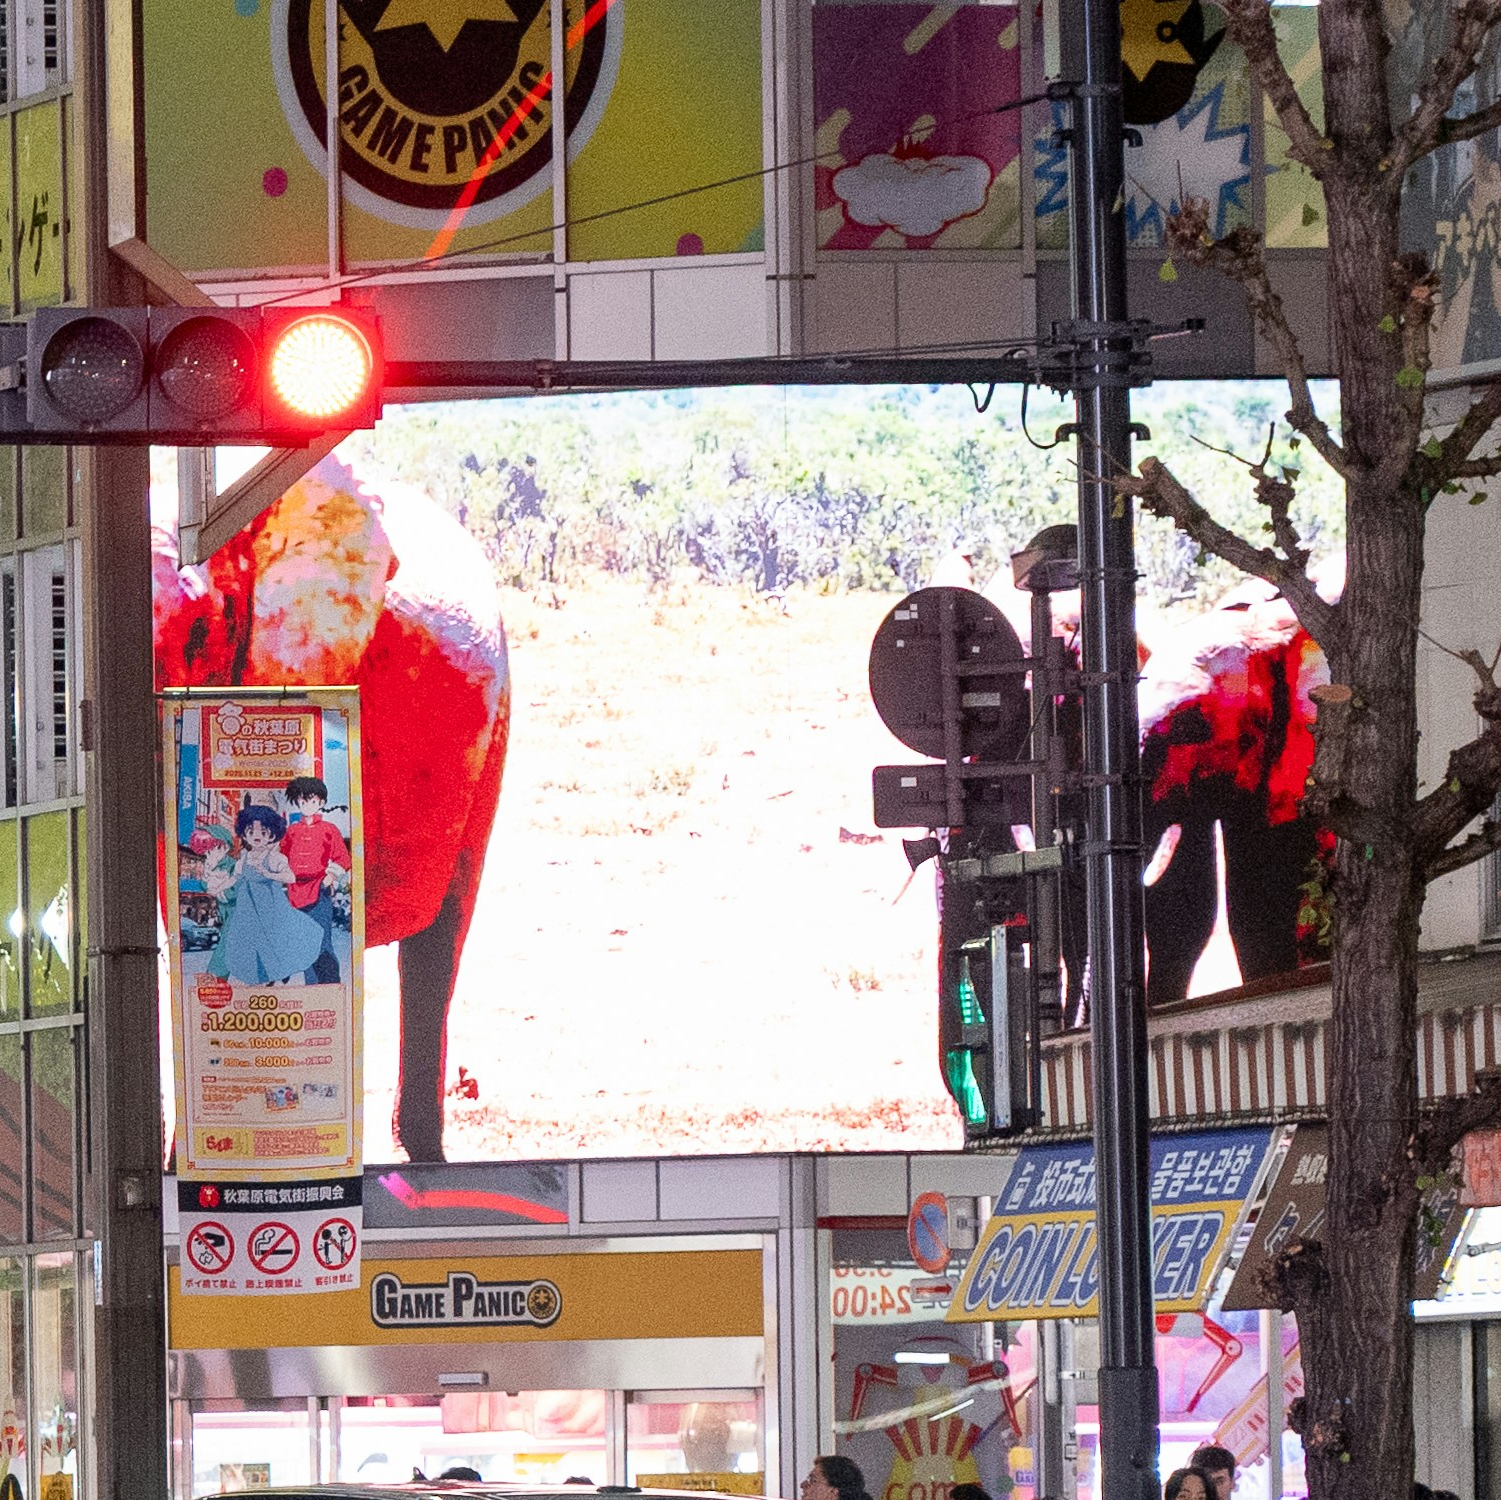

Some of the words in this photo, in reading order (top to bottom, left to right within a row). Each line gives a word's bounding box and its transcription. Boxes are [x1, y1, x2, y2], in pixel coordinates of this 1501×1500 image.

[339, 64, 436, 174] GAME
[224, 1185, 345, 1204] 秋葉原電気街振興会
[965, 1221, 1068, 1312] COIN
[1052, 1211, 1225, 1306] LOER
[376, 1278, 446, 1319] GAME
[452, 1277, 526, 1318] PANIC
